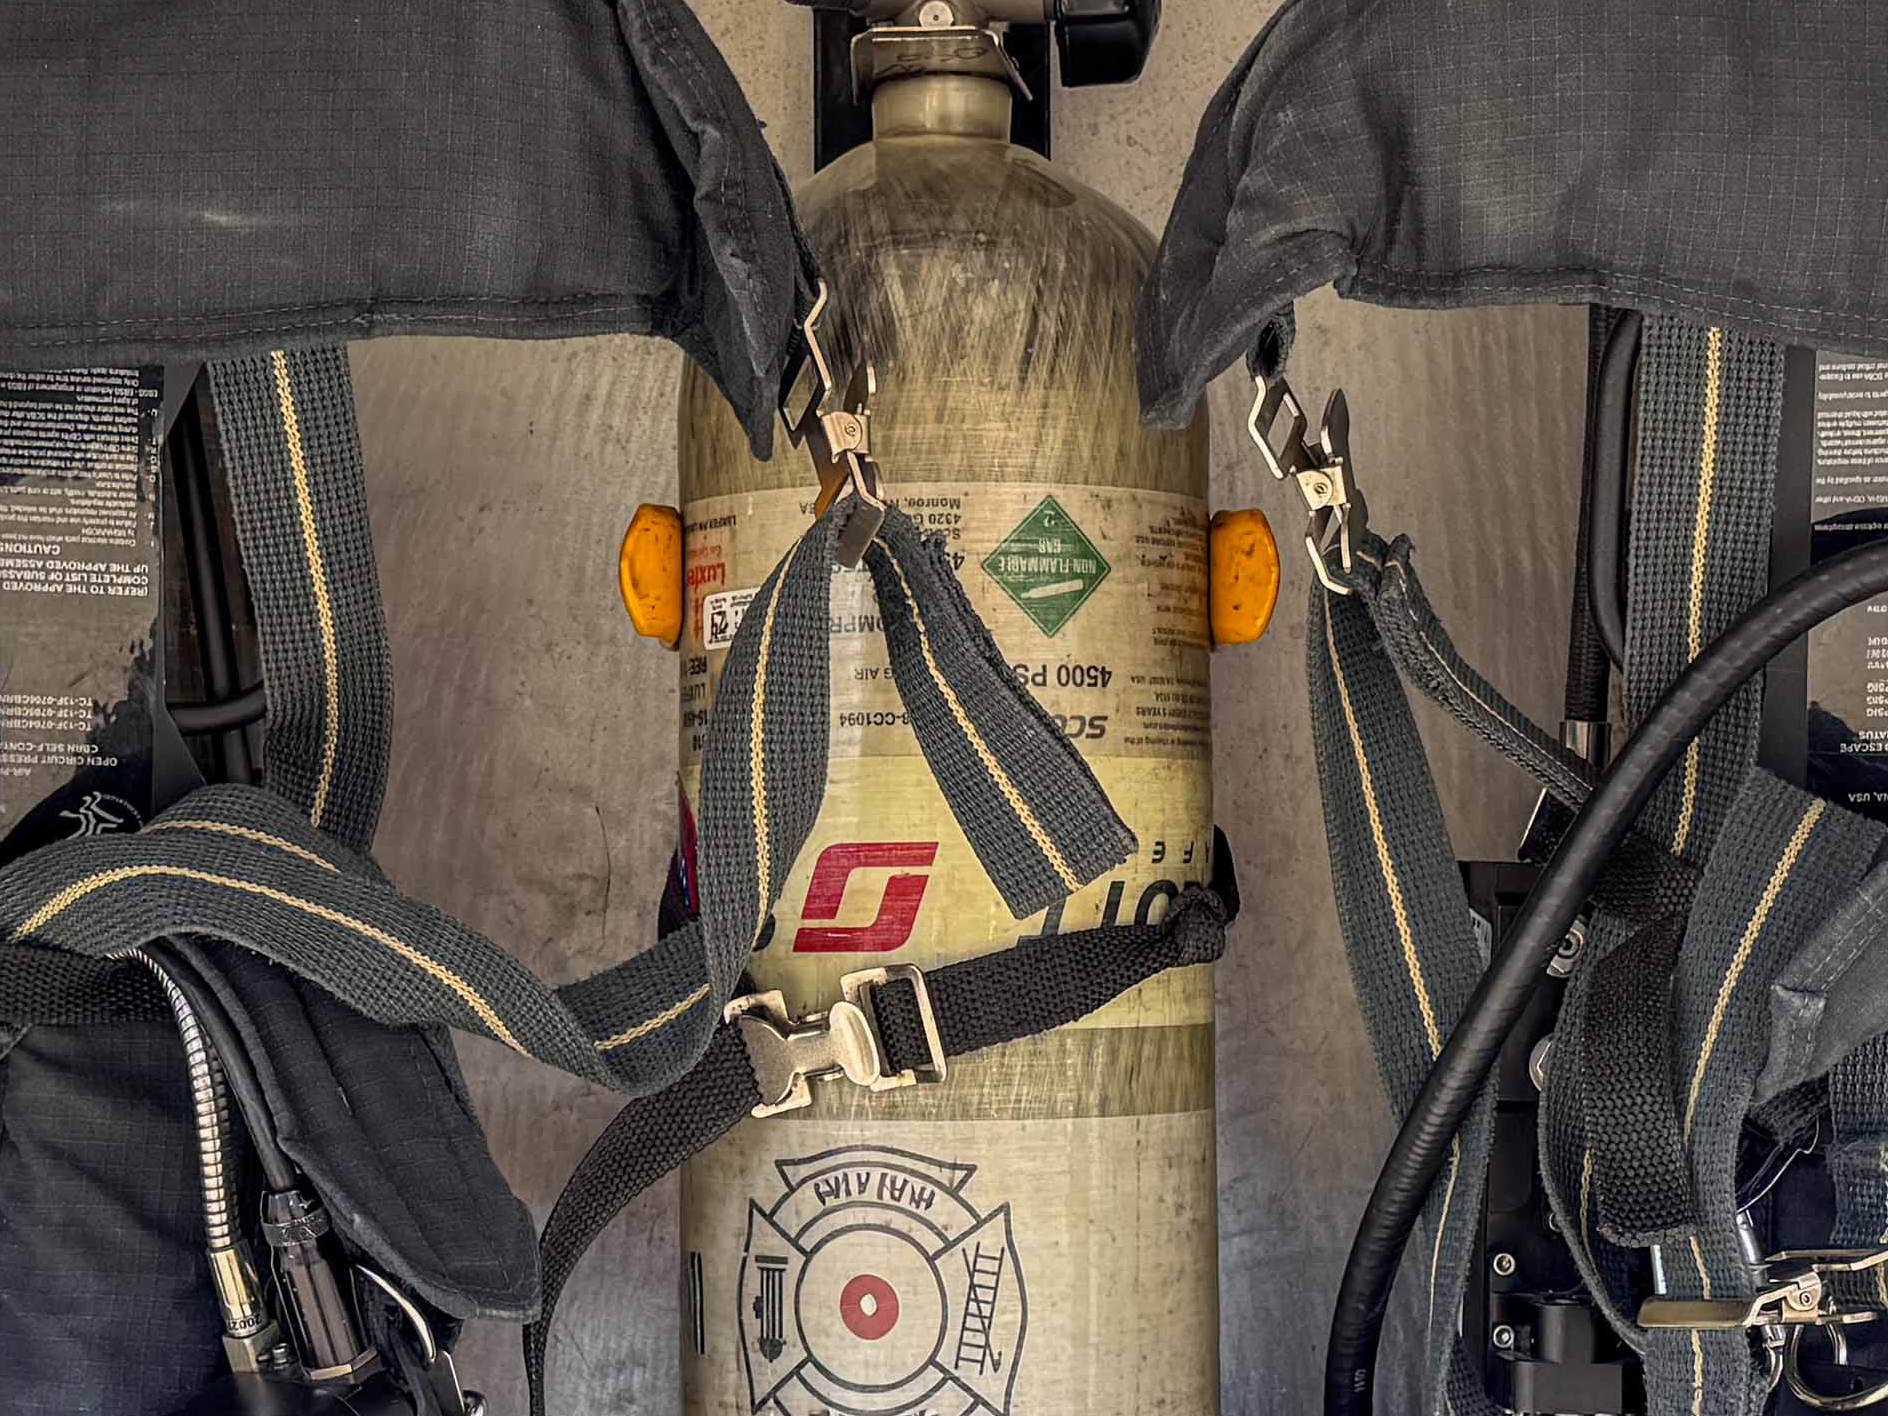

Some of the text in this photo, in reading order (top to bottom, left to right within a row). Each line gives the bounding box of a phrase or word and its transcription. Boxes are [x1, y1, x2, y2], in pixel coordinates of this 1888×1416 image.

[927, 514, 961, 524] 4320
[46, 561, 107, 571] APPROVED
[111, 564, 130, 572] THE
[134, 564, 148, 572] UP
[48, 572, 62, 580] OF
[65, 572, 87, 582] LIST
[90, 574, 148, 584] COMPLETE
[2, 581, 63, 592] APPROVED
[66, 584, 87, 593] THE
[90, 585, 104, 595] TO
[108, 585, 148, 596] (REFER
[855, 668, 880, 679] AIR
[1057, 665, 1111, 687] 4500
[1840, 742, 1882, 752] ESCAPE
[41, 755, 84, 765] CIRCUIT
[87, 757, 117, 766] OPEN
[1848, 793, 1870, 802] USA
